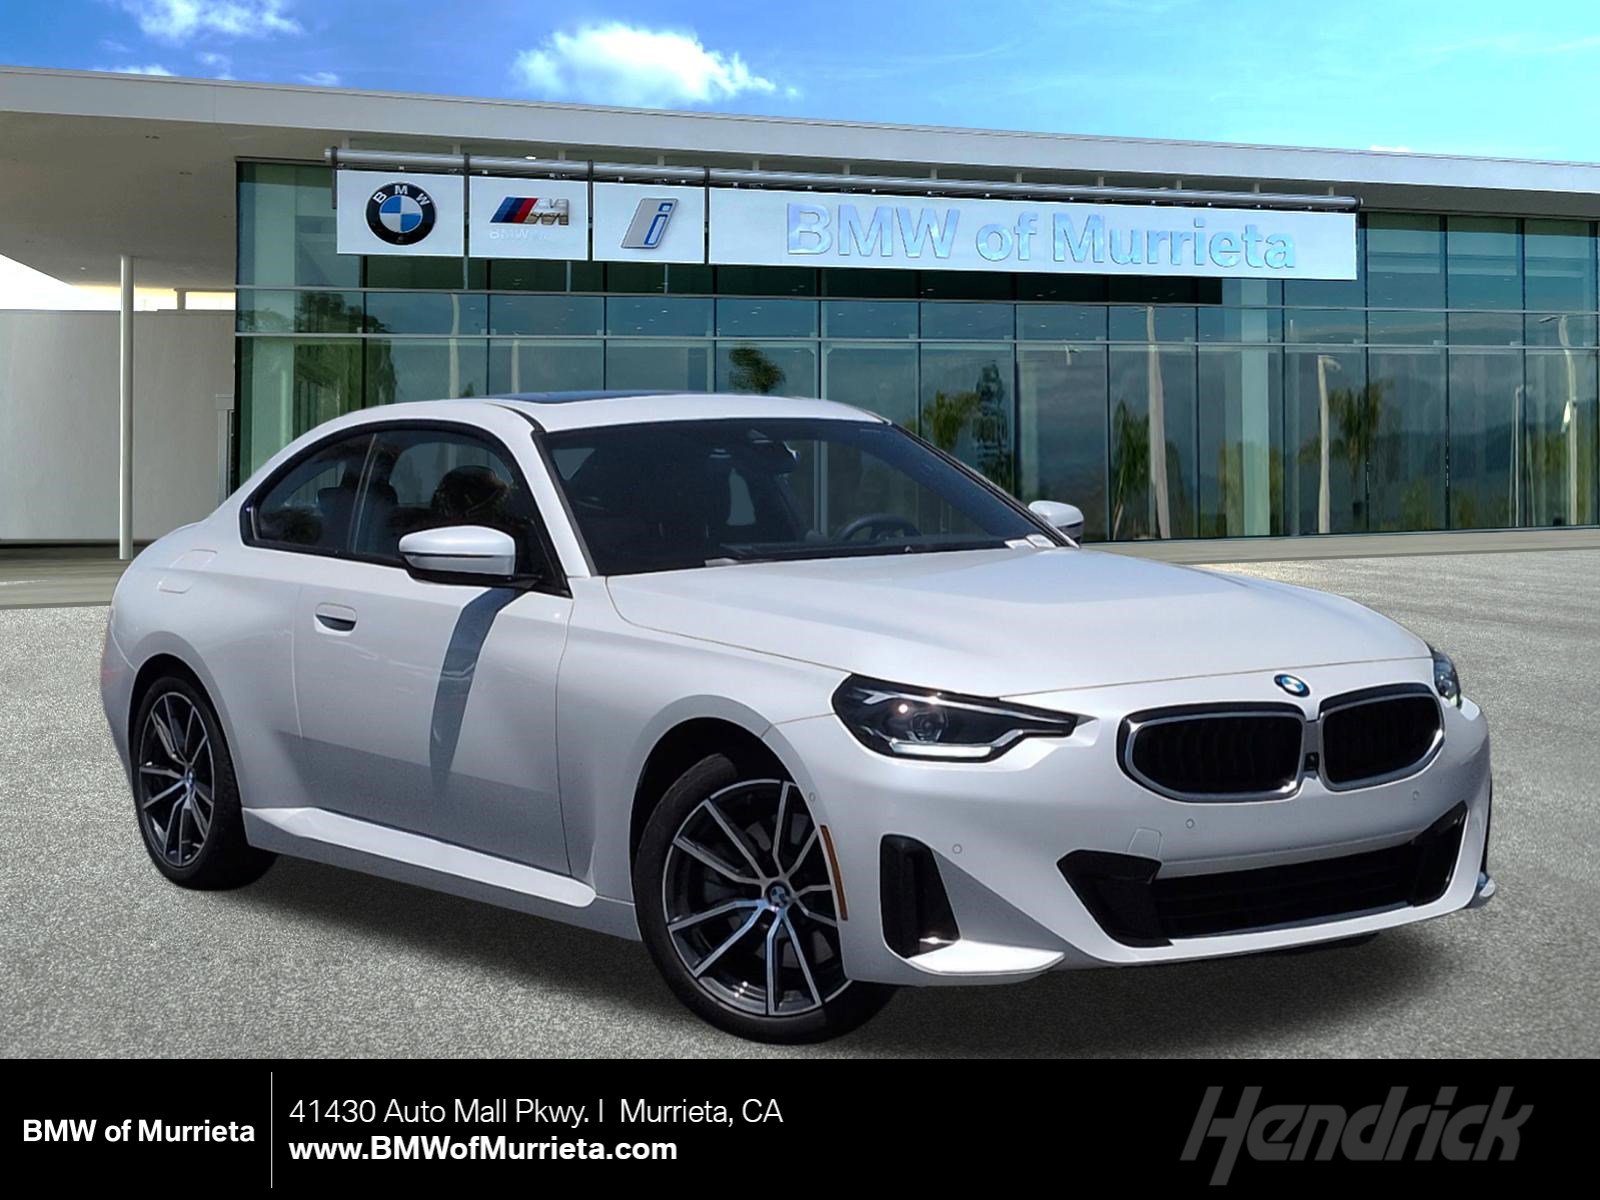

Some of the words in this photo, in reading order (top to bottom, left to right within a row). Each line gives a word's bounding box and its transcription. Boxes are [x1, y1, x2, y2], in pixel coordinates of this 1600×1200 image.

[372, 184, 431, 206] BMW
[787, 203, 960, 258] BMW
[976, 212, 1038, 262] of
[1052, 212, 1296, 270] Murrieta
